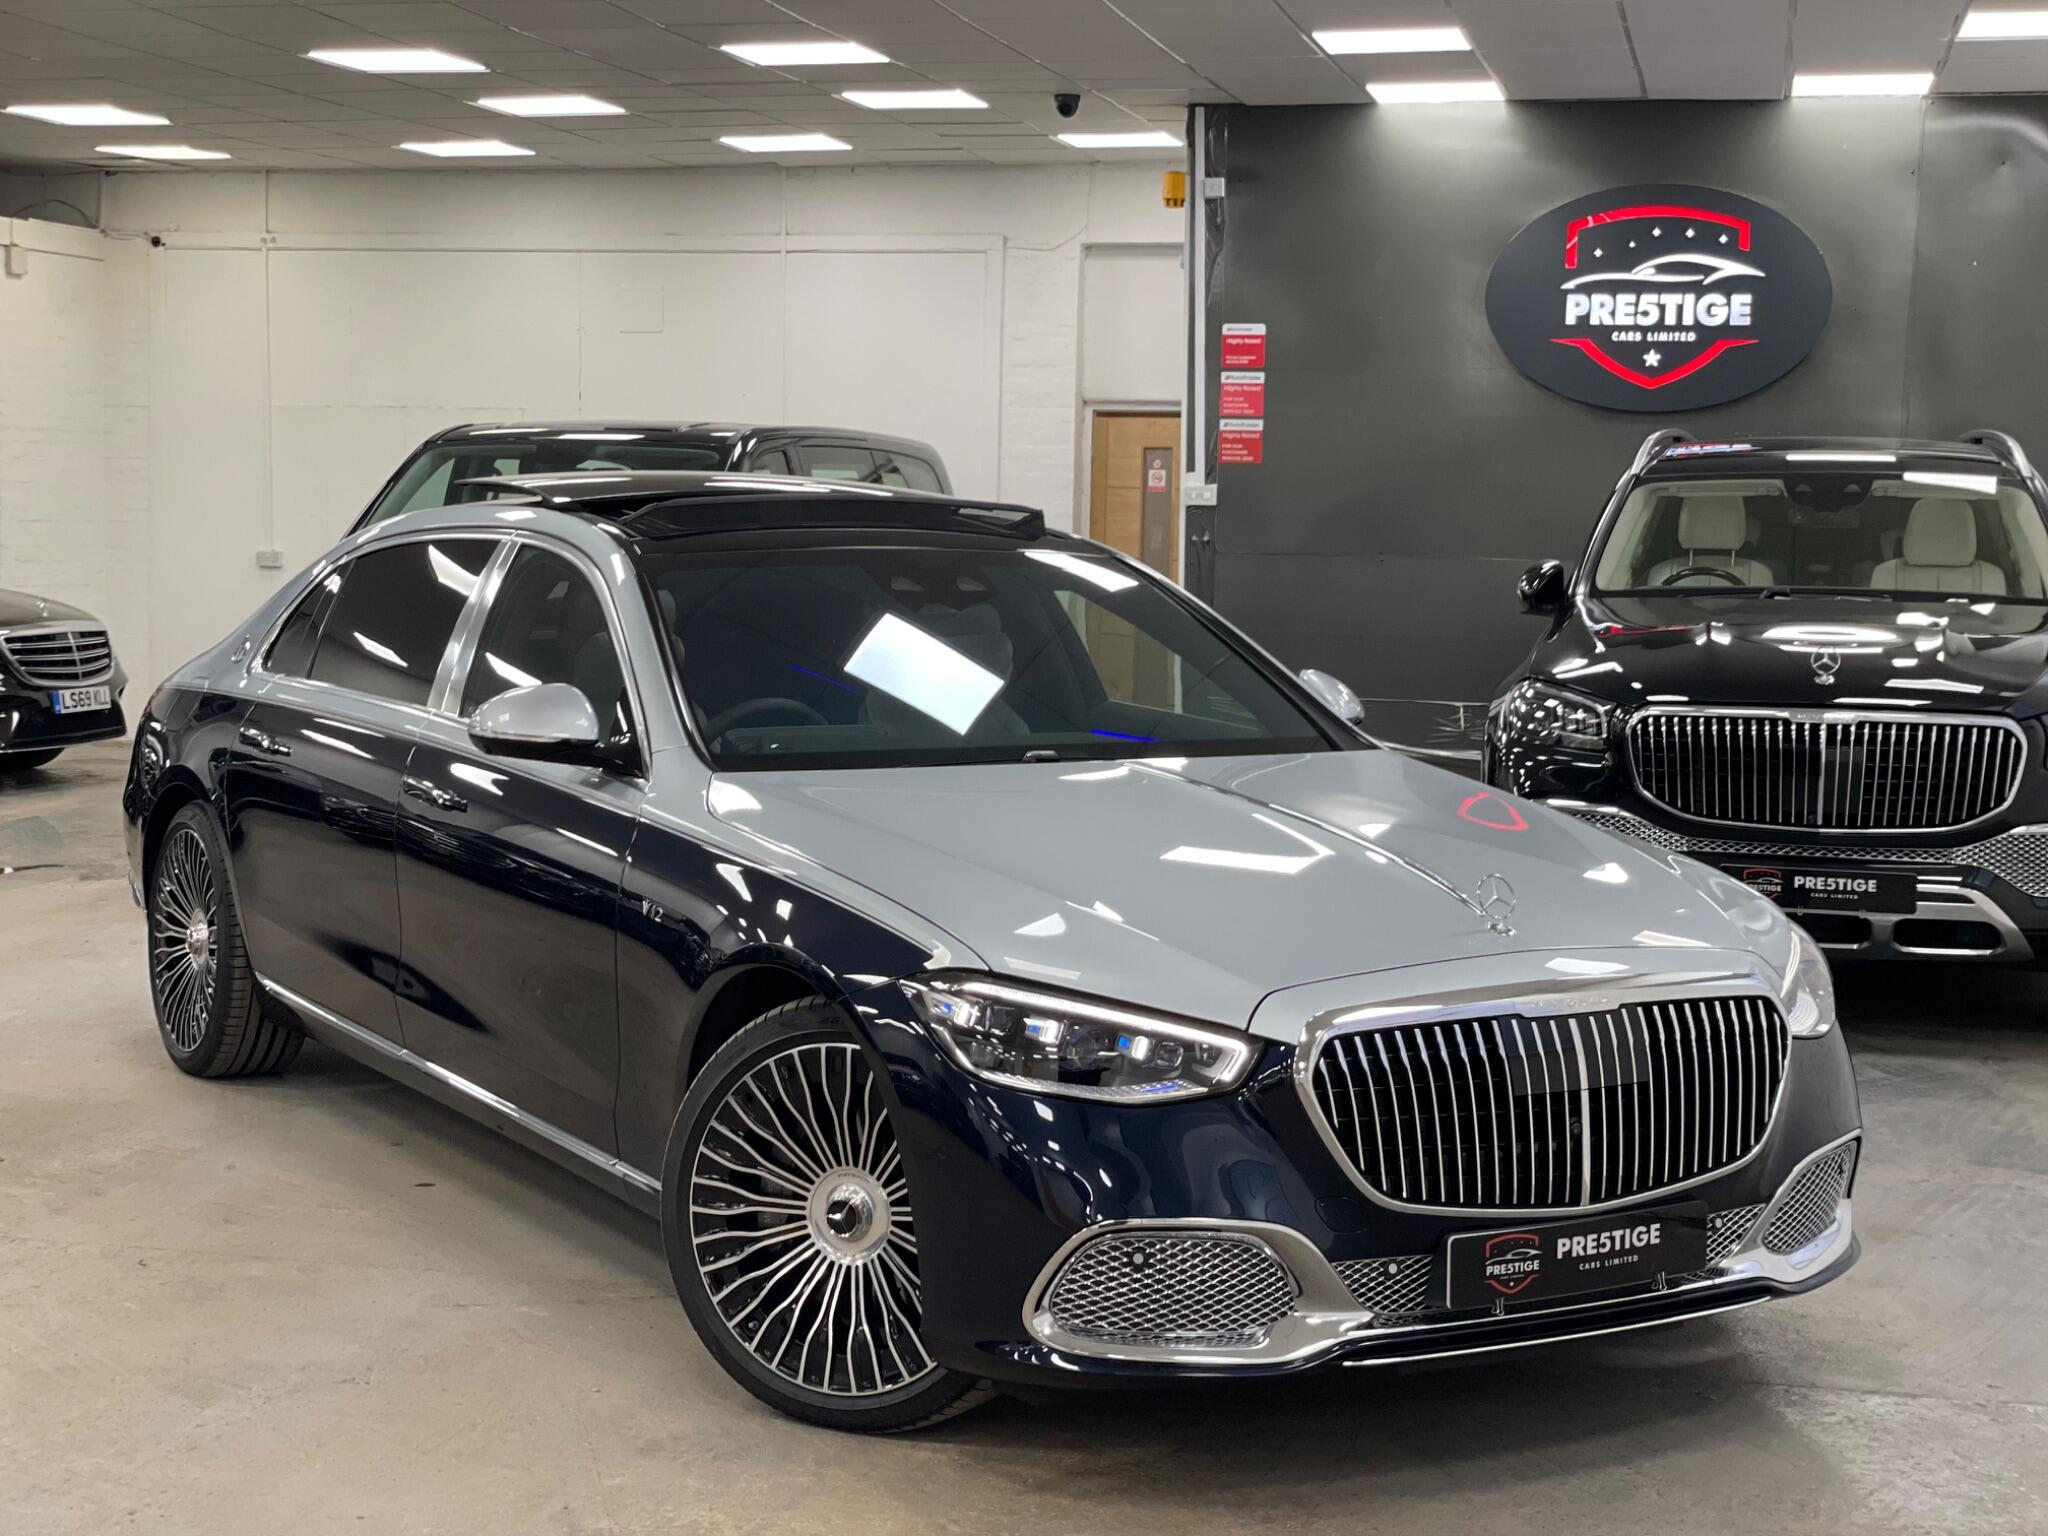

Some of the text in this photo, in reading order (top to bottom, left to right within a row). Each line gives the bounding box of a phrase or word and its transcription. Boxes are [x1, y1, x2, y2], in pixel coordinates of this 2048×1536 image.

[1611, 331, 1696, 342] CARS LIMITED
[62, 691, 92, 709] LS69
[1579, 1255, 1639, 1271] CARS LIMITED
